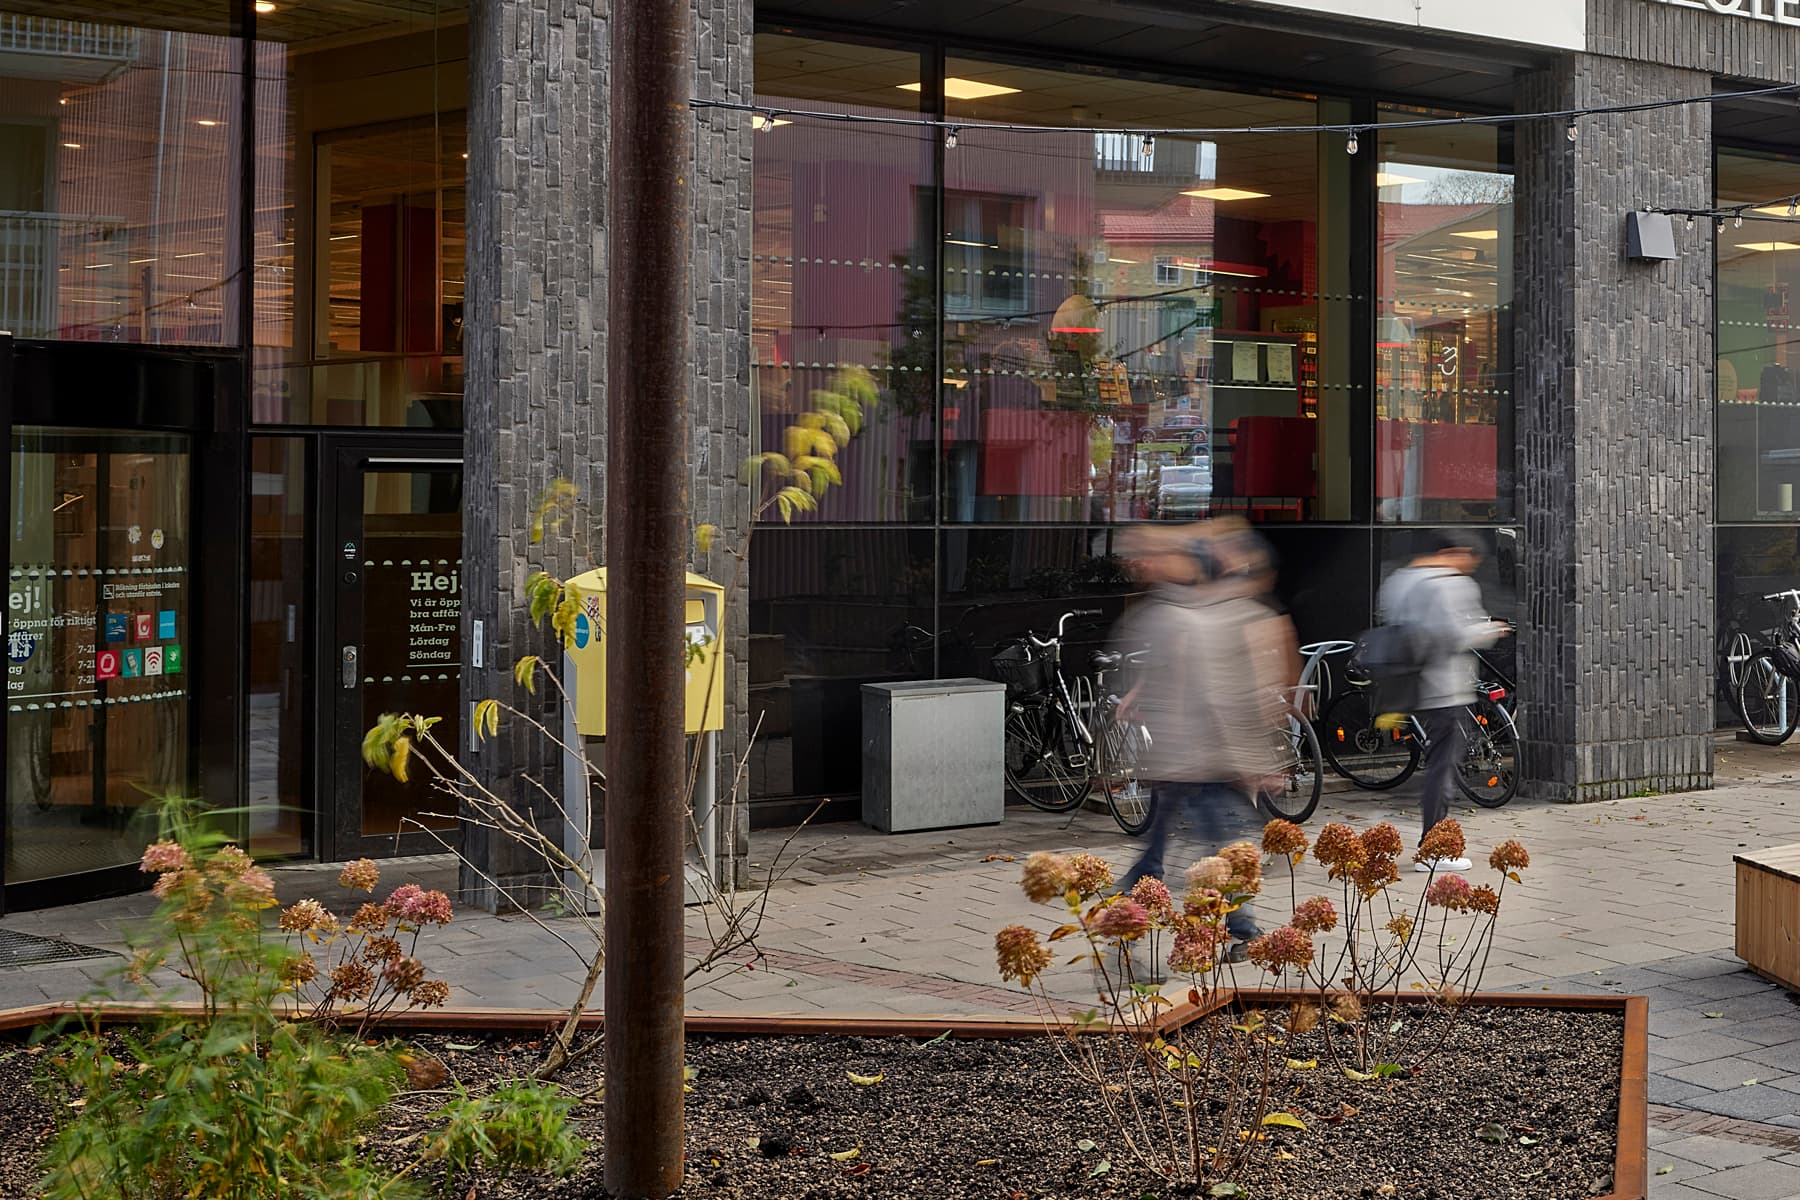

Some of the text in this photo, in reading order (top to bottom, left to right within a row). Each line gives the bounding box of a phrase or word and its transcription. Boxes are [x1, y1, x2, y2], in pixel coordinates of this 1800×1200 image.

[9, 585, 41, 613] ej!
[410, 598, 462, 608] Vi är öpp
[410, 610, 430, 618] bra
[13, 618, 48, 630] öppna
[50, 615, 65, 627] för
[409, 623, 456, 632] Mån-Fre
[409, 637, 450, 646] Lördag
[79, 644, 96, 654] 7-21
[409, 650, 451, 660] Söndag
[78, 660, 96, 669] 7-21
[78, 675, 96, 684] 7-21
